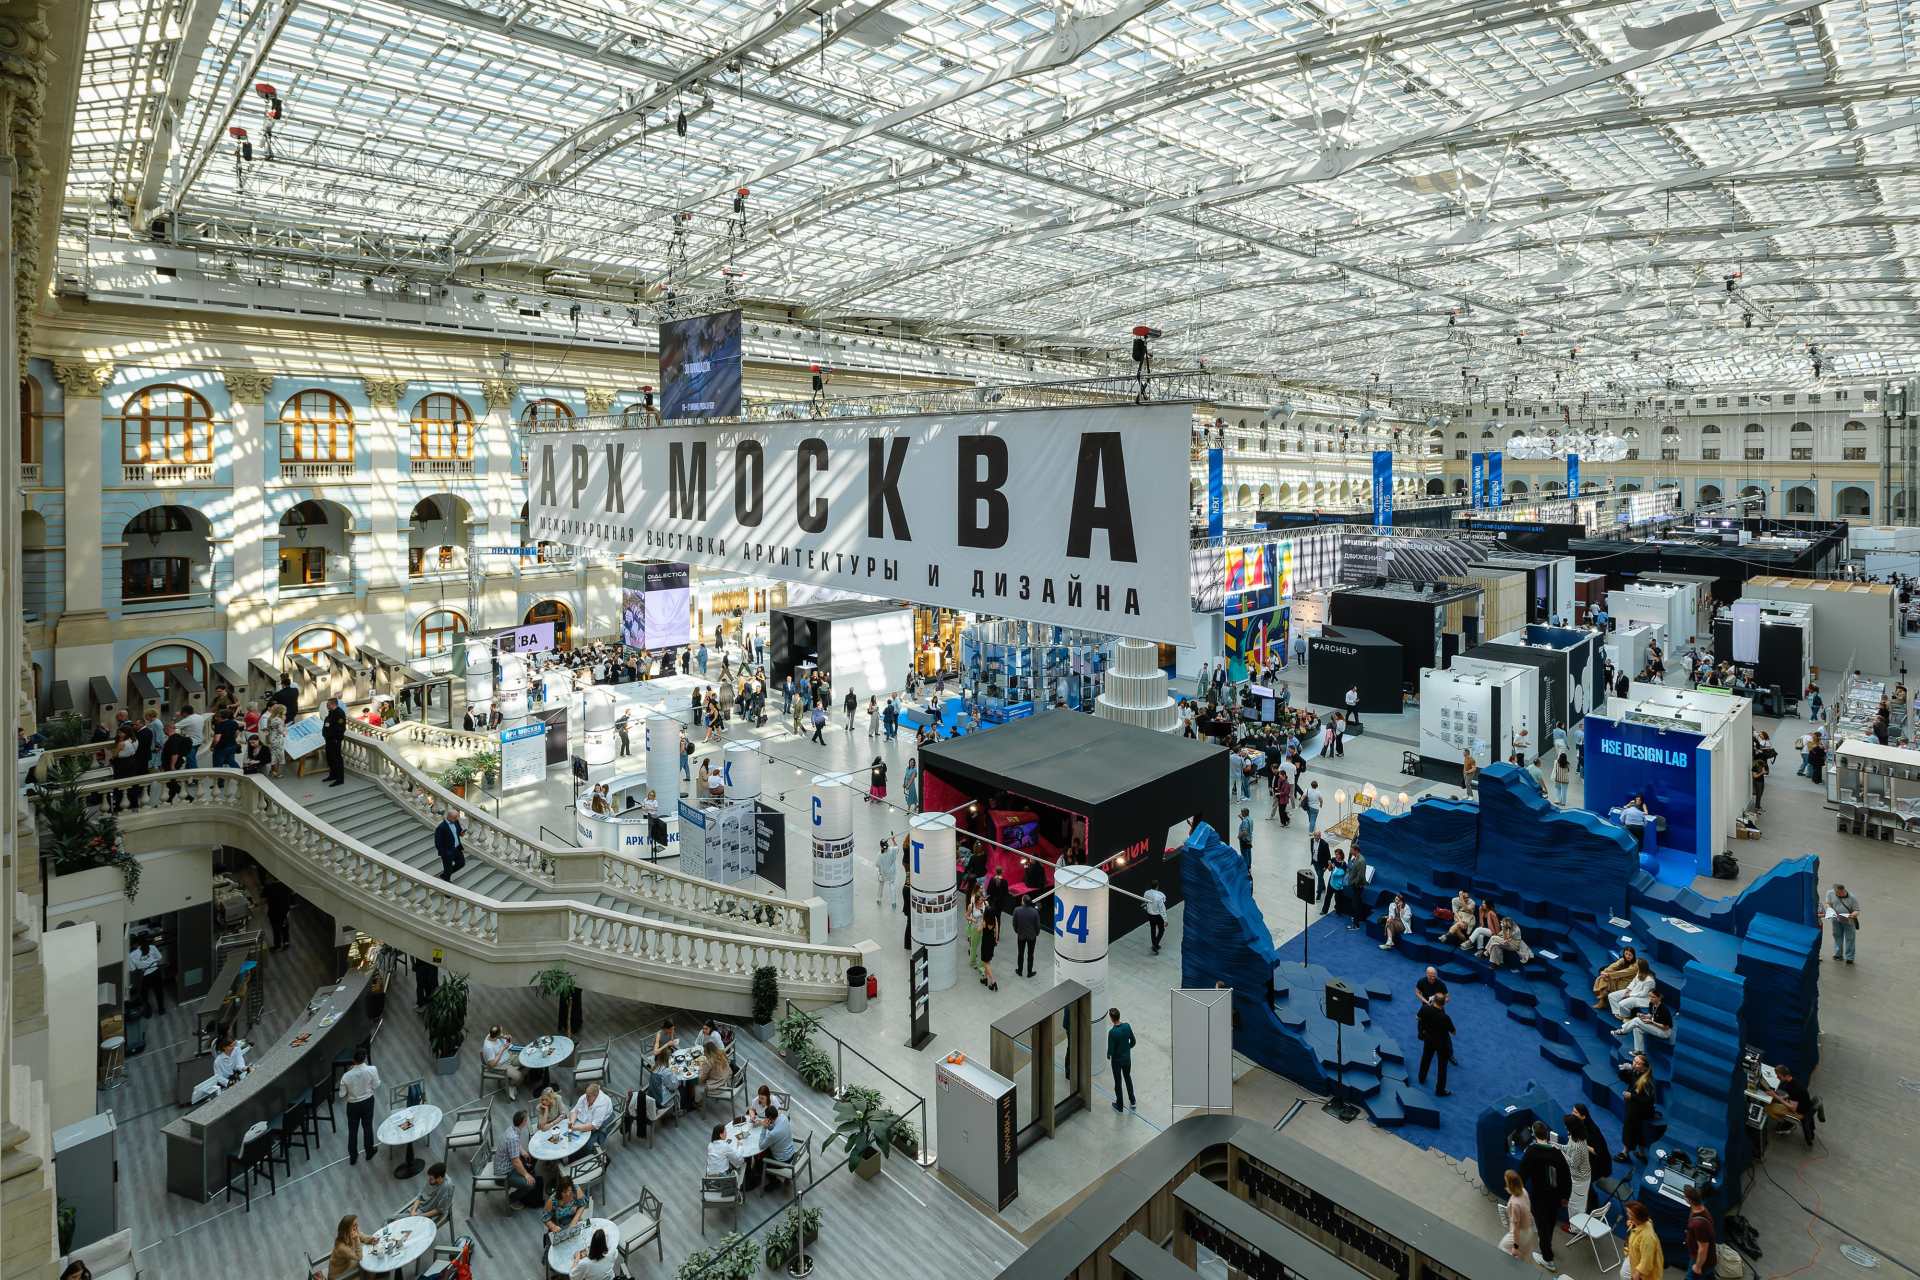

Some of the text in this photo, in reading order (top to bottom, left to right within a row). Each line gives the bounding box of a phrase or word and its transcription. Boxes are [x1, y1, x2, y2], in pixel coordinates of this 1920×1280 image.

[540, 431, 1138, 563] АРХ МОСКВА
[1212, 496, 1220, 514] NEXT
[1343, 552, 1384, 562] ДВИЖЕНИЕ
[540, 516, 1141, 616] МЕЖДУНАРОДНАЯ ВЫСТАВКА АРХИТЕКТУРЫ И ДИЗАЙНА
[647, 571, 688, 580] DIALECTICA
[518, 633, 538, 648] ВА
[1319, 643, 1358, 655] ARCHELP
[1601, 738, 1688, 768] HSE DESIGN LAB
[625, 836, 644, 846] АРХ
